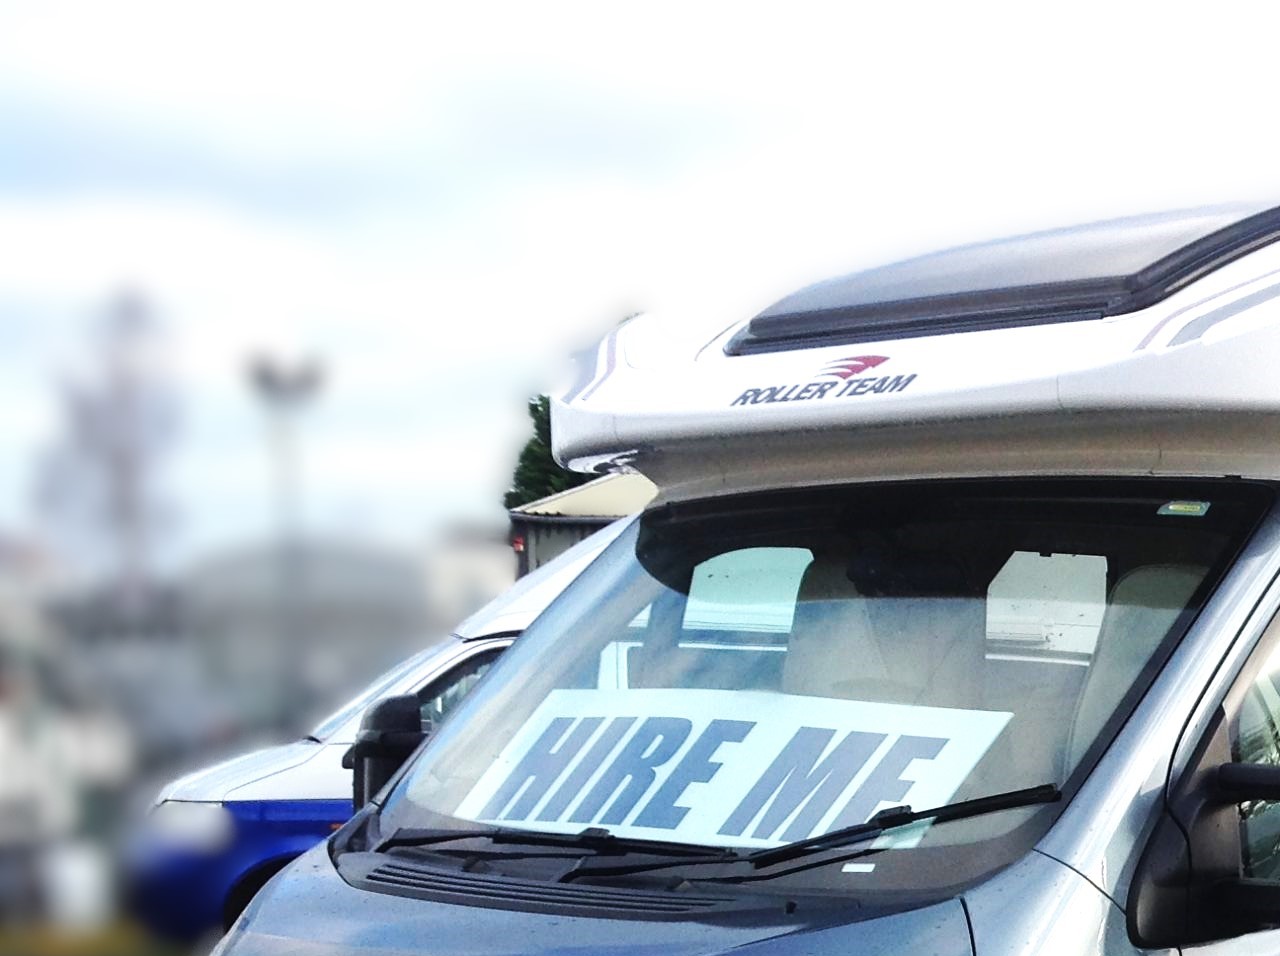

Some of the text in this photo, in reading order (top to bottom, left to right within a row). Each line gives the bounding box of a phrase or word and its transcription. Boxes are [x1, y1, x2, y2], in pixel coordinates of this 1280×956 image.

[730, 373, 918, 406] ROLLER TEAM
[475, 716, 757, 830] HIRE
